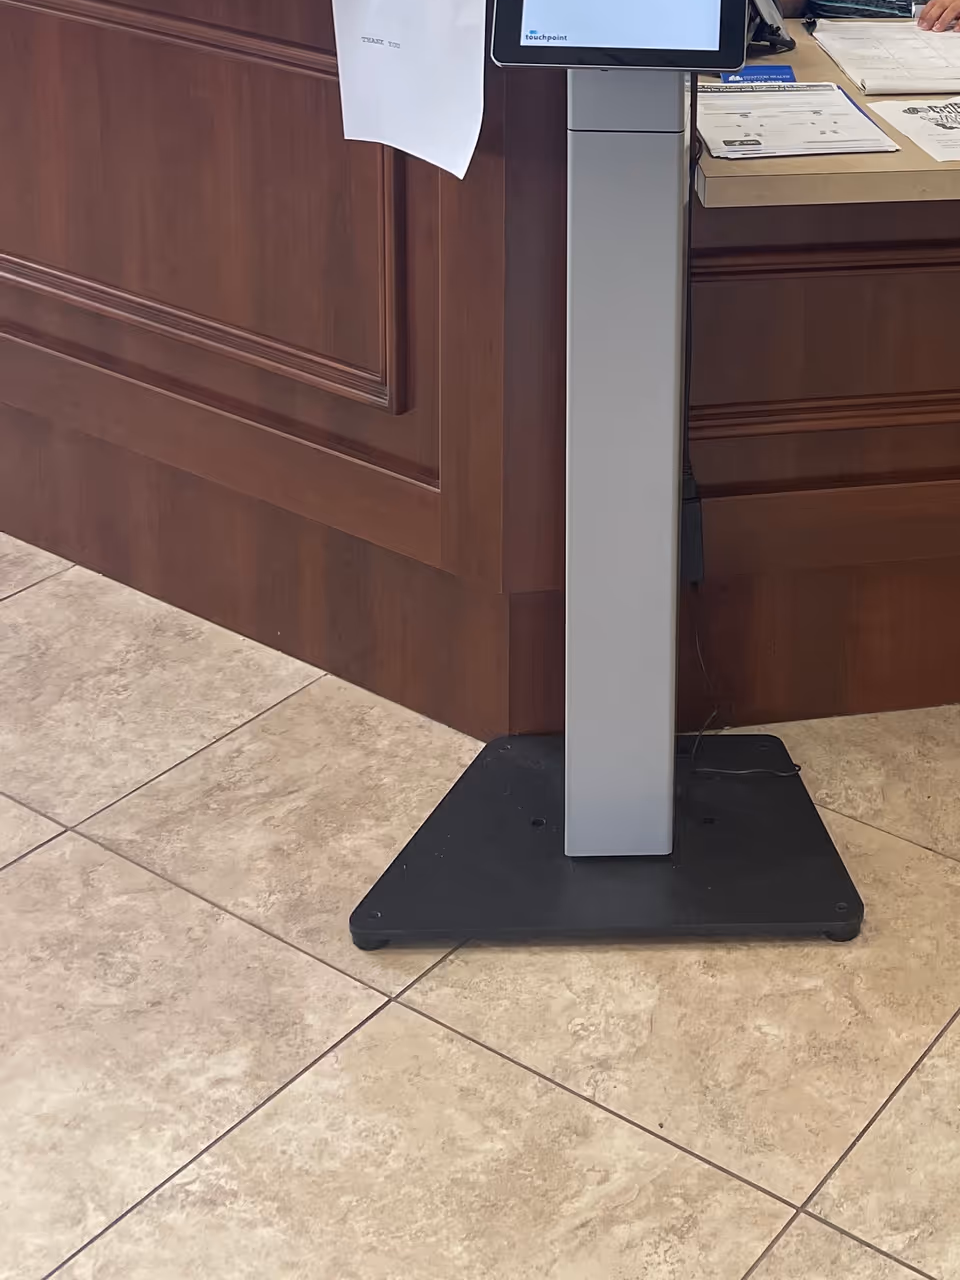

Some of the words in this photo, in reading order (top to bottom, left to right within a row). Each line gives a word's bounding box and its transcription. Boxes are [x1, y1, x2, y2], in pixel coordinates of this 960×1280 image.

[361, 36, 384, 45] THANK
[388, 40, 401, 49] YOU
[525, 34, 568, 42] touchpoint
